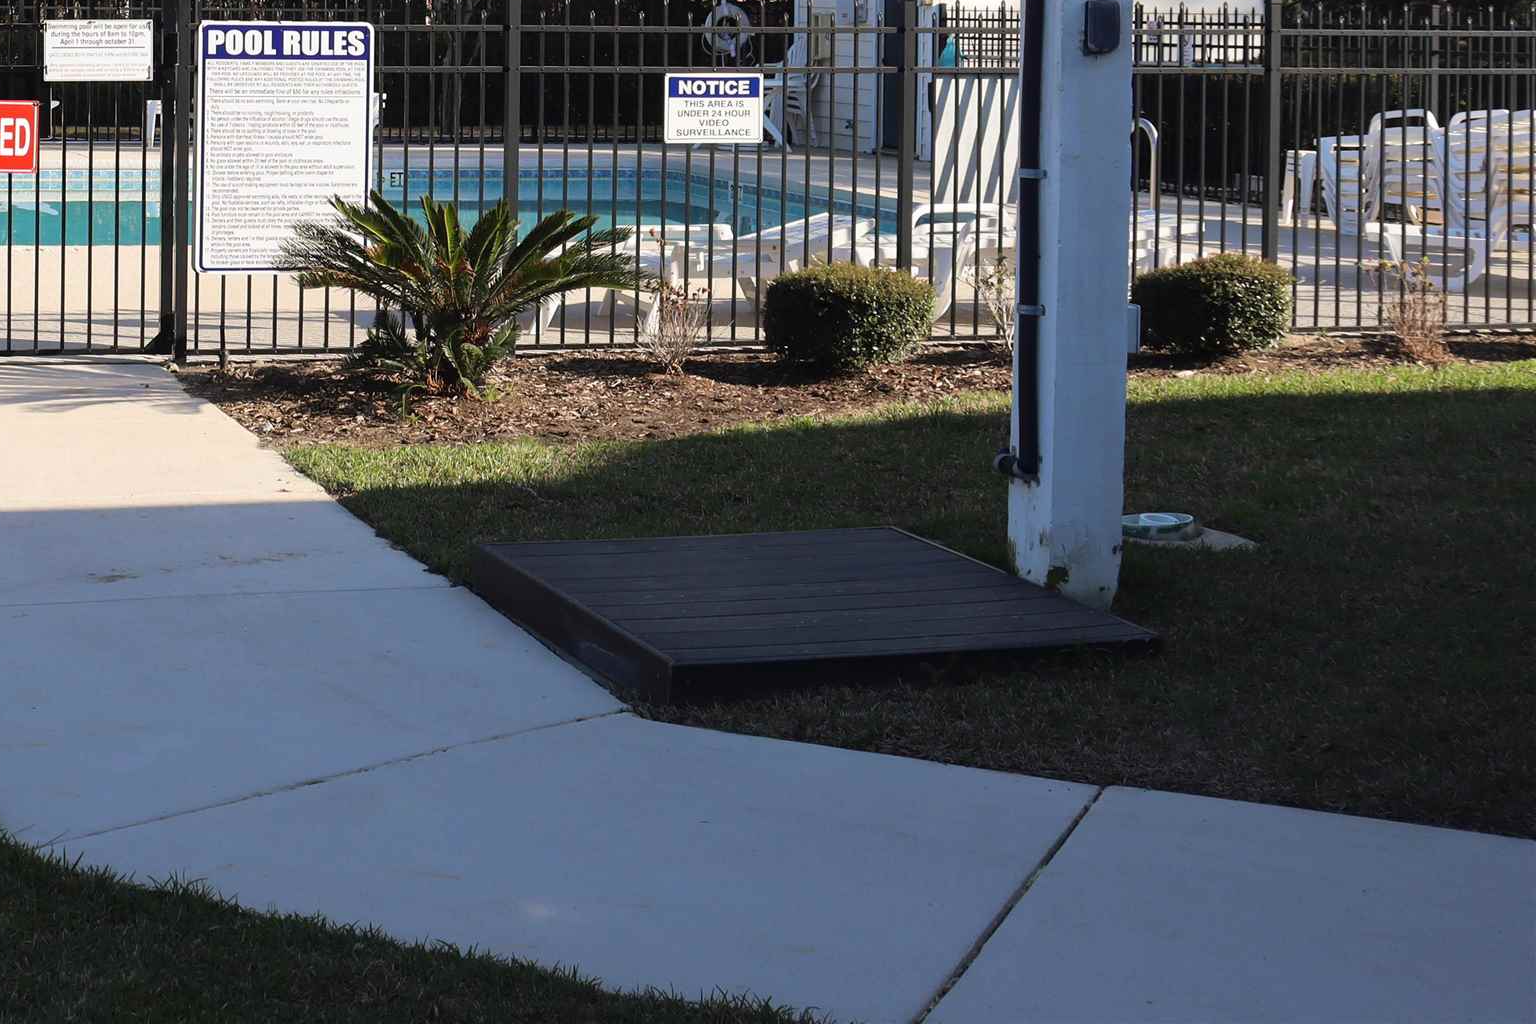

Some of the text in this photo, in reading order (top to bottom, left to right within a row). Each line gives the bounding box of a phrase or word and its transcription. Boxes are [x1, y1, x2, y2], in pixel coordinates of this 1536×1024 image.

[207, 30, 365, 56] POOL RULES
[678, 80, 750, 95] NOTICE
[684, 100, 745, 108] THIS AREA IS
[677, 110, 751, 118] UNDER 24 HOUR
[676, 128, 752, 136] SURVEILLANCE
